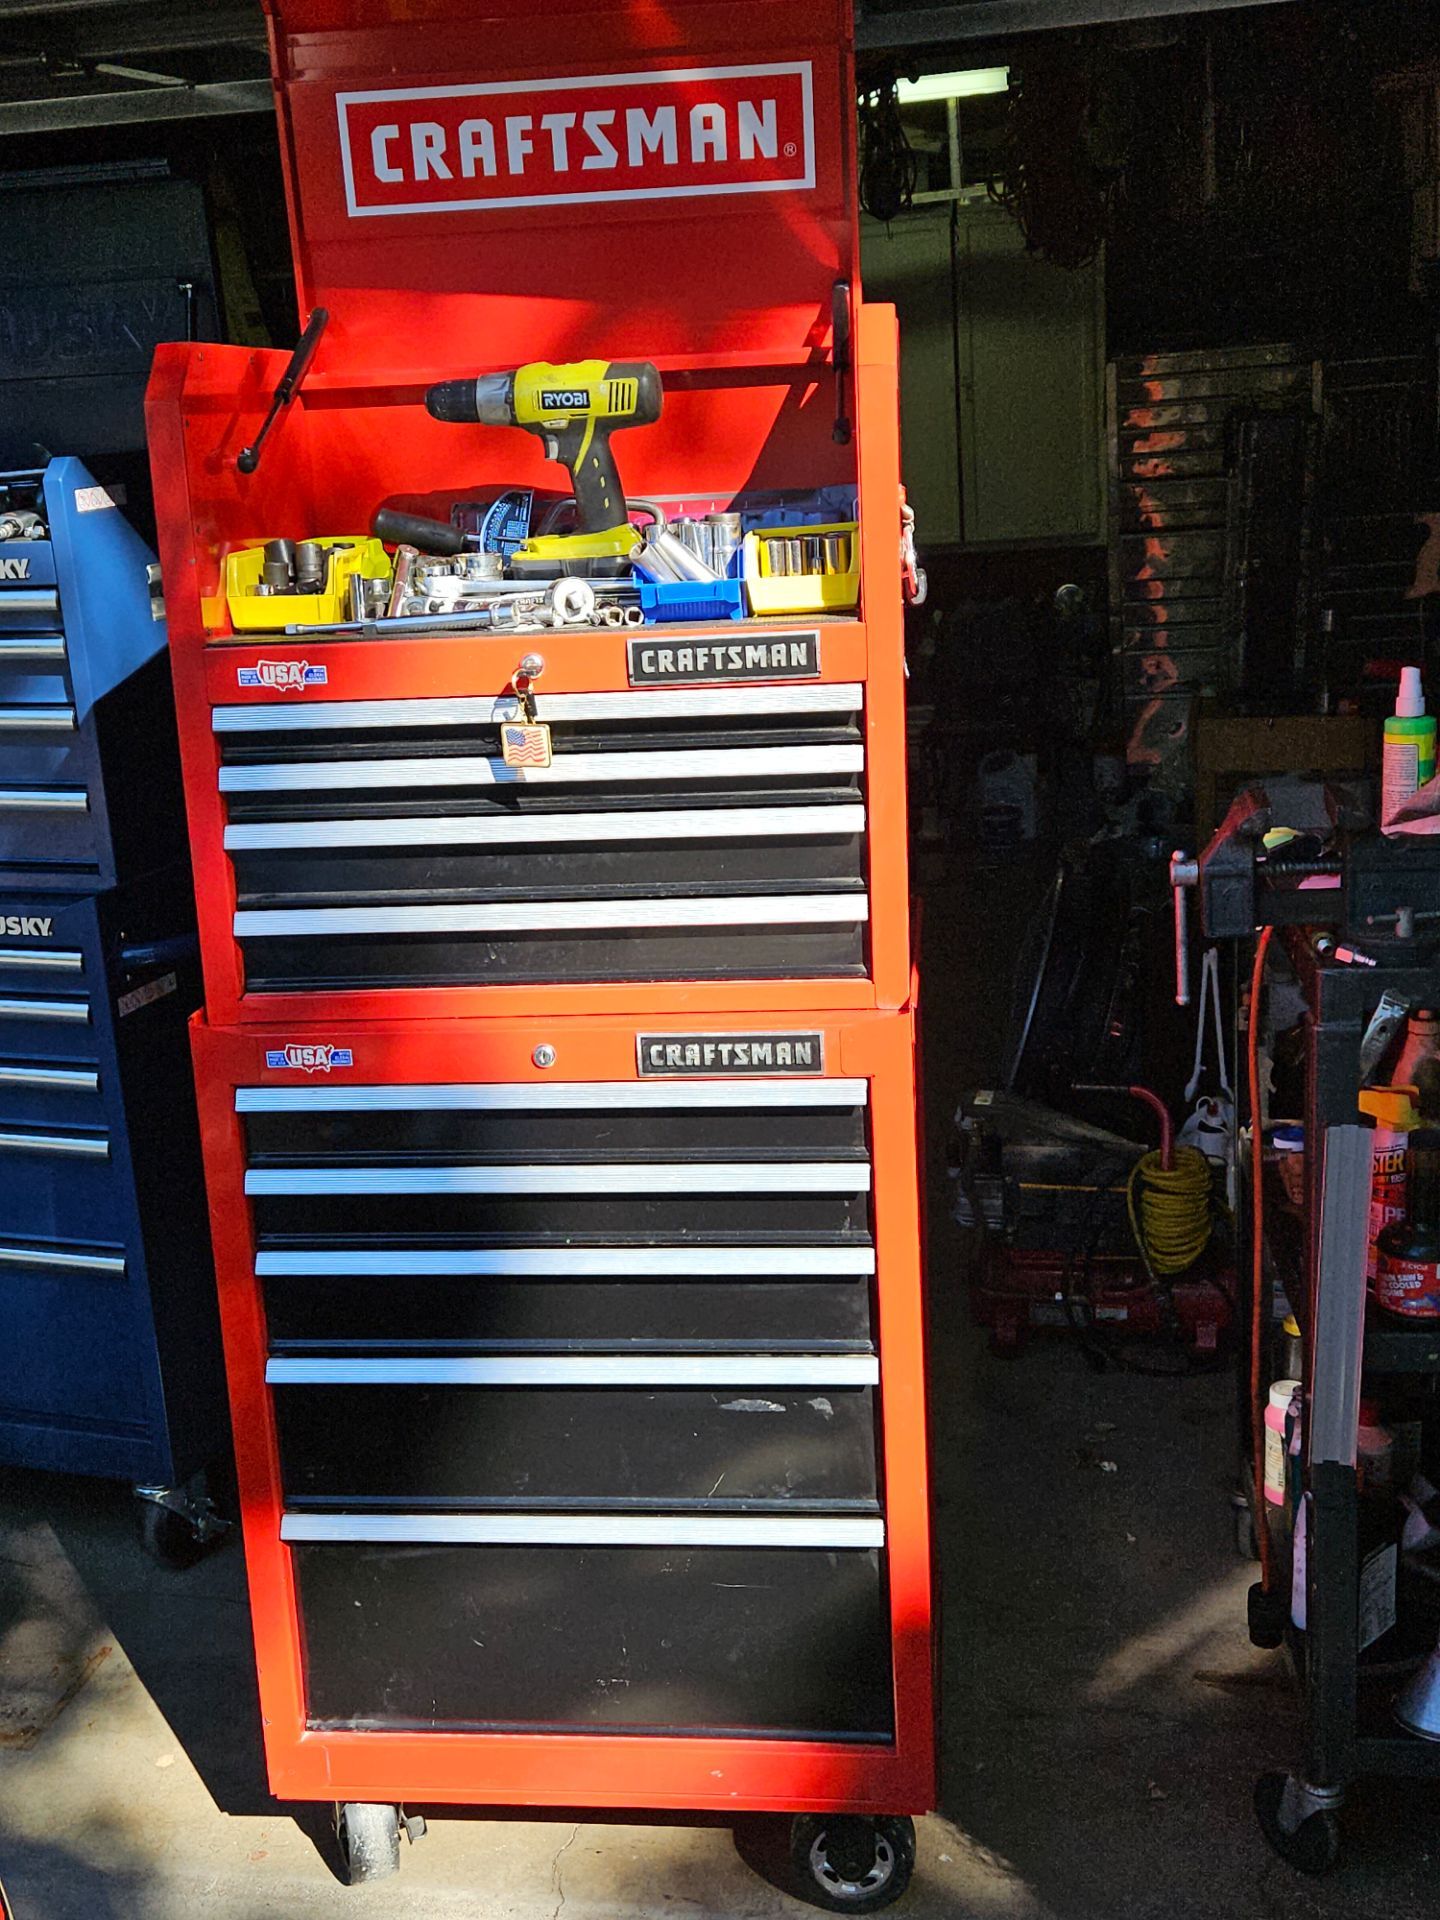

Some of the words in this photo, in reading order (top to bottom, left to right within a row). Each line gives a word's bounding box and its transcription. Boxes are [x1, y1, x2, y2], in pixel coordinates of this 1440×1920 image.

[543, 392, 588, 406] RYOBI
[641, 642, 807, 673] CRAFTSMAN
[262, 664, 303, 683] USA
[290, 1047, 328, 1065] USA
[649, 1042, 811, 1066] CRAFTSMAN
[1388, 1281, 1422, 1289] COOLED
